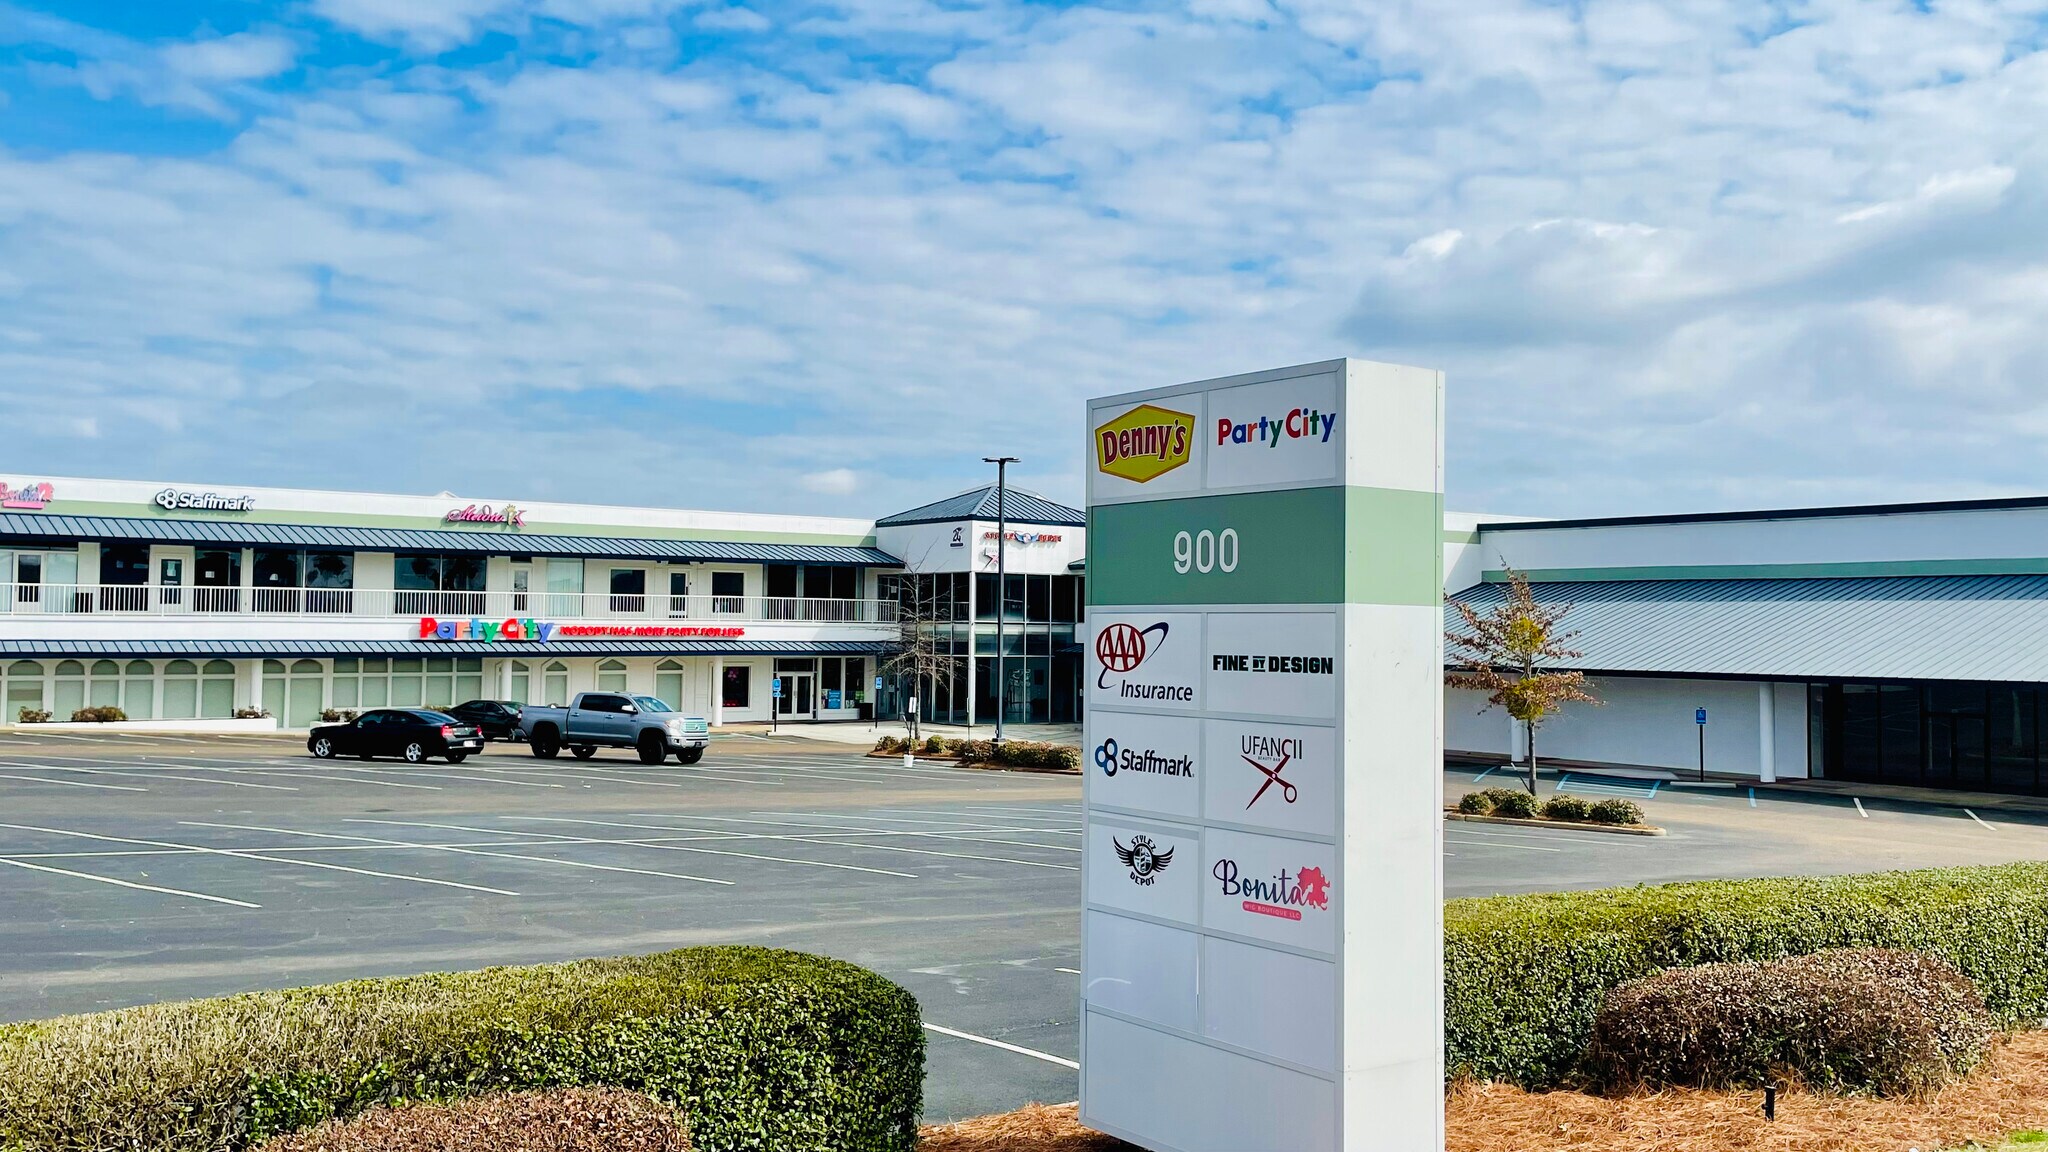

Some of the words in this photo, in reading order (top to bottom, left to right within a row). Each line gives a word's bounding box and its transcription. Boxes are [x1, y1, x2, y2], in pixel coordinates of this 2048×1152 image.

[1101, 419, 1187, 465] Denny's
[178, 491, 255, 511] Staffmark
[1173, 528, 1239, 574] 900
[559, 626, 608, 636] NOBODY
[609, 626, 633, 636] HAS
[634, 627, 666, 636] MORE
[666, 627, 700, 637] PARTY
[700, 627, 721, 637] FOR
[722, 627, 745, 637] LESS
[1099, 625, 1143, 671] AAA
[1213, 655, 1249, 671] FINE
[1268, 656, 1334, 675] DESIGN
[1121, 679, 1193, 701] Insurance
[1241, 734, 1303, 760] UFANCII
[1120, 748, 1194, 777] Staffmark
[1130, 871, 1155, 887] DEPOT
[1213, 859, 1309, 906] Bonita
[1257, 905, 1288, 915] BOUTIQUE
